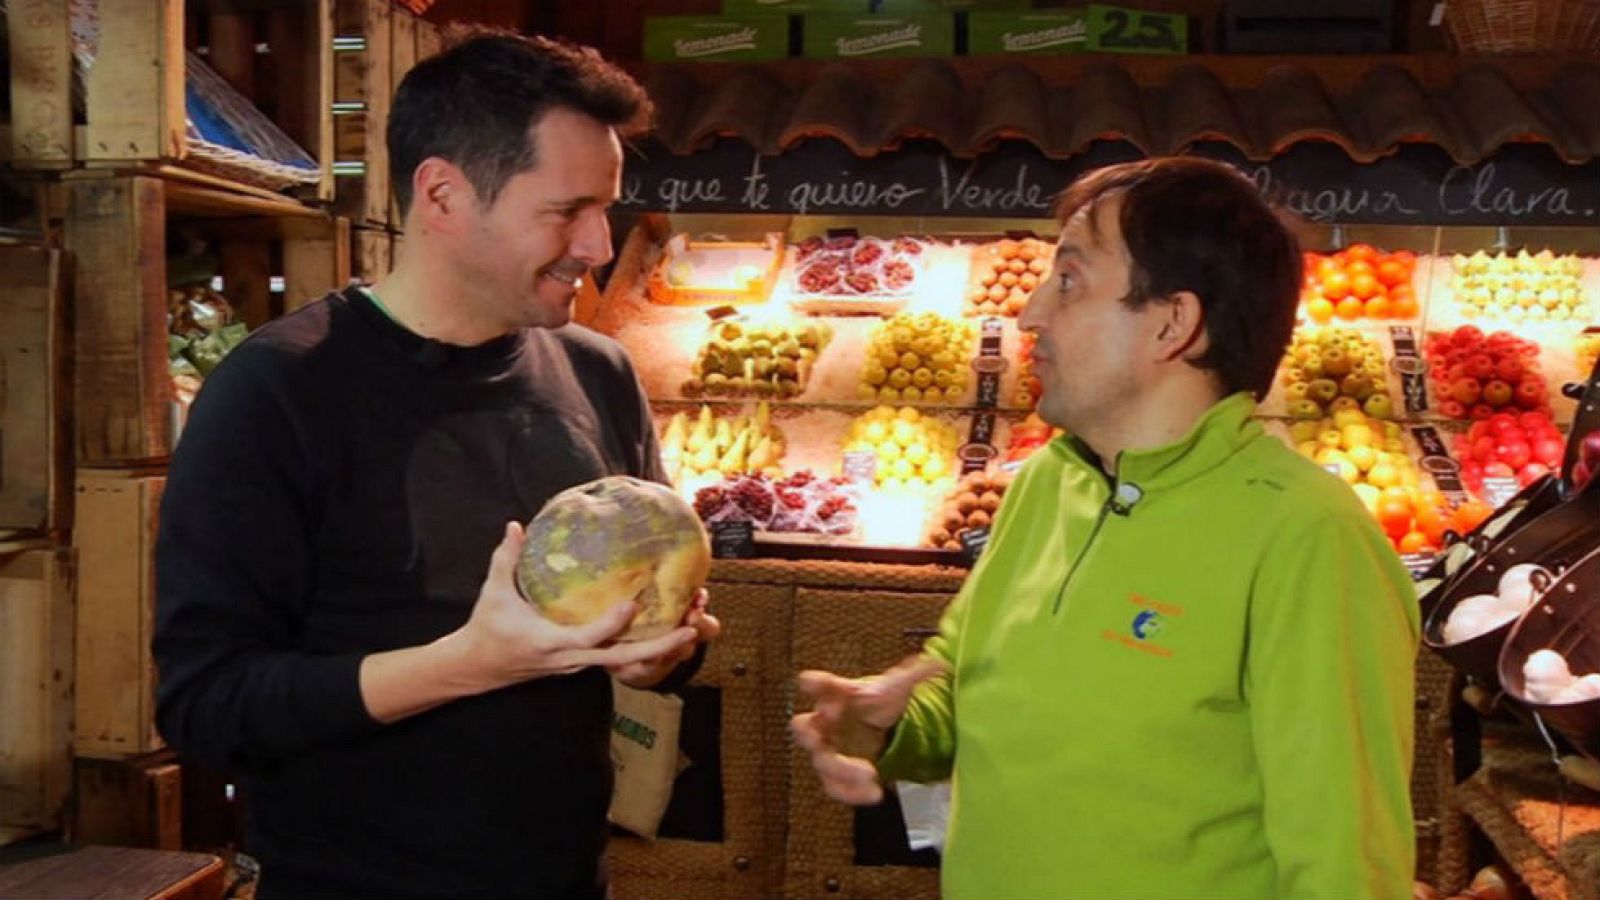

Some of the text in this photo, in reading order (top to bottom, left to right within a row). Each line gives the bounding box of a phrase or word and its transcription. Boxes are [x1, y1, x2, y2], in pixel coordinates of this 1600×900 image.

[658, 176, 728, 211] que
[741, 153, 771, 209] te
[788, 171, 924, 214] quiero
[939, 157, 1053, 210] Verde
